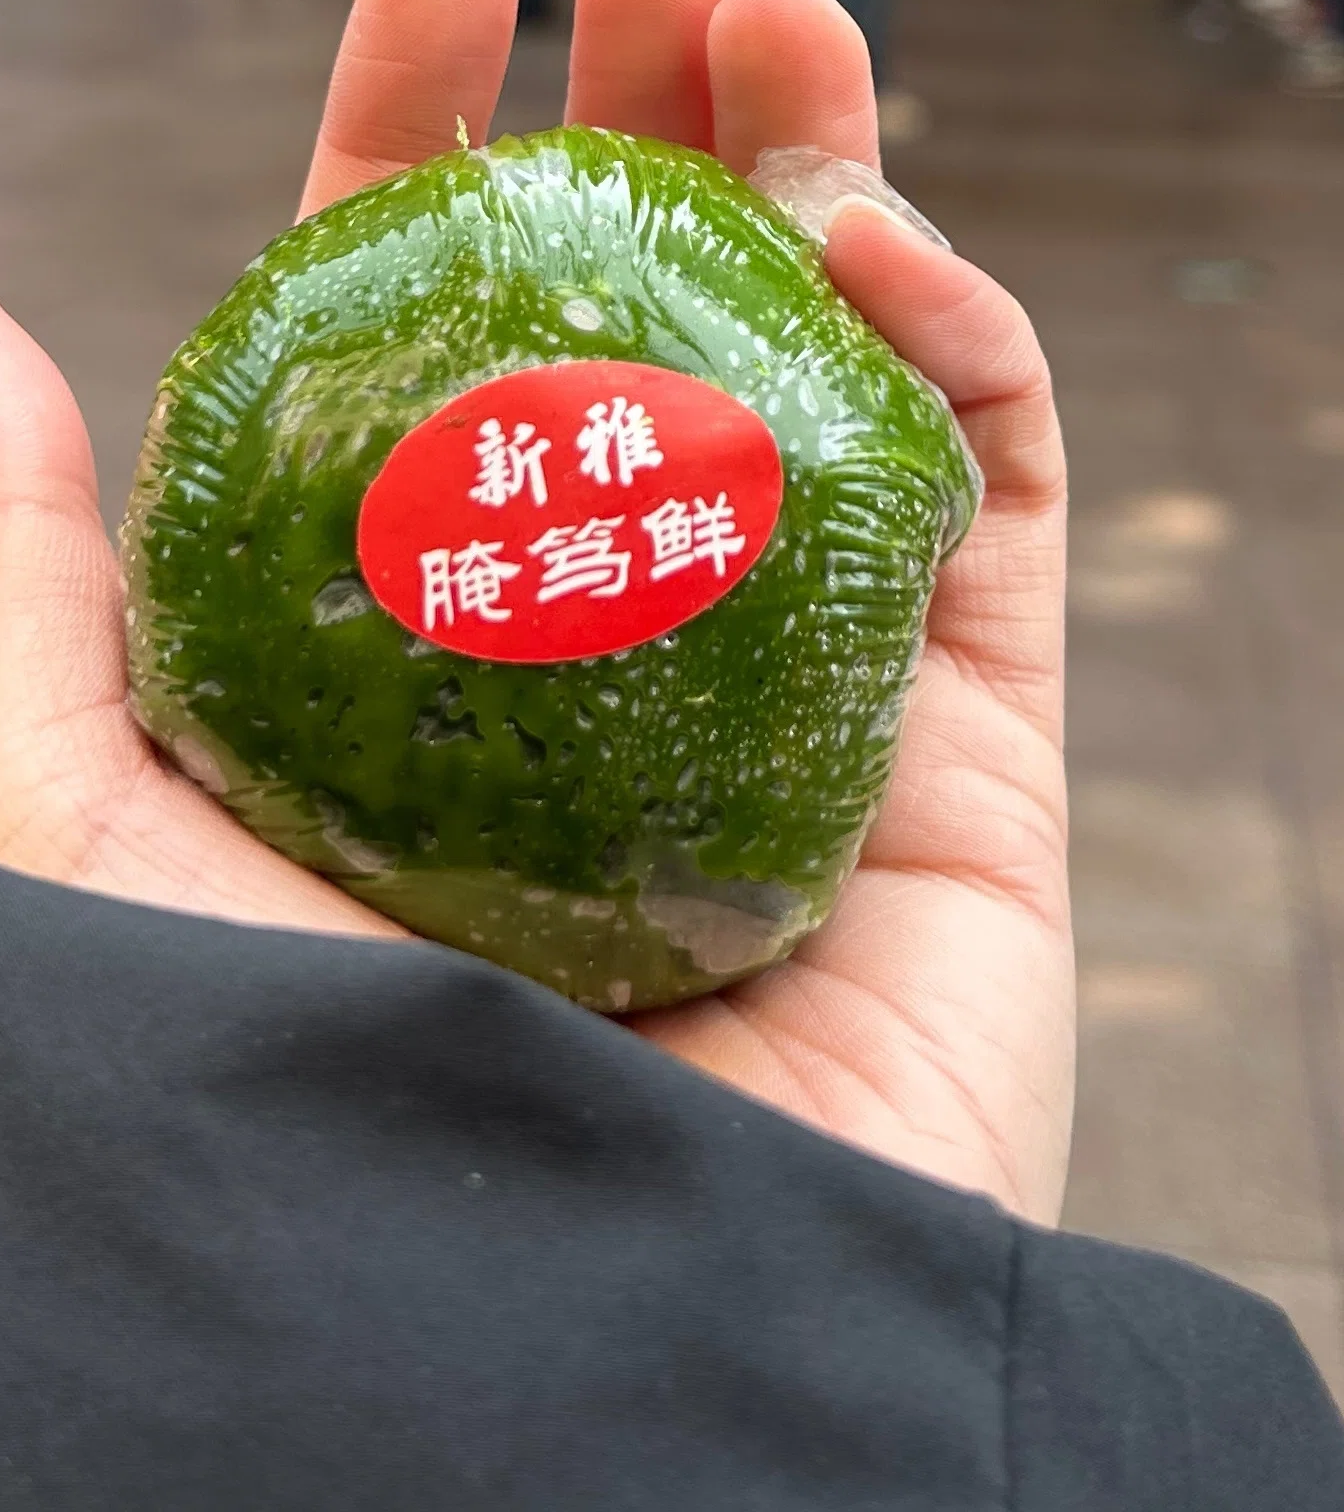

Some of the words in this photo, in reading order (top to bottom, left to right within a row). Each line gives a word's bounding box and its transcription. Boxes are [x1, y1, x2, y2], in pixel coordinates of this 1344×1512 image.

[468, 395, 664, 509] 新雅
[418, 490, 747, 633] 腌笃鲜
